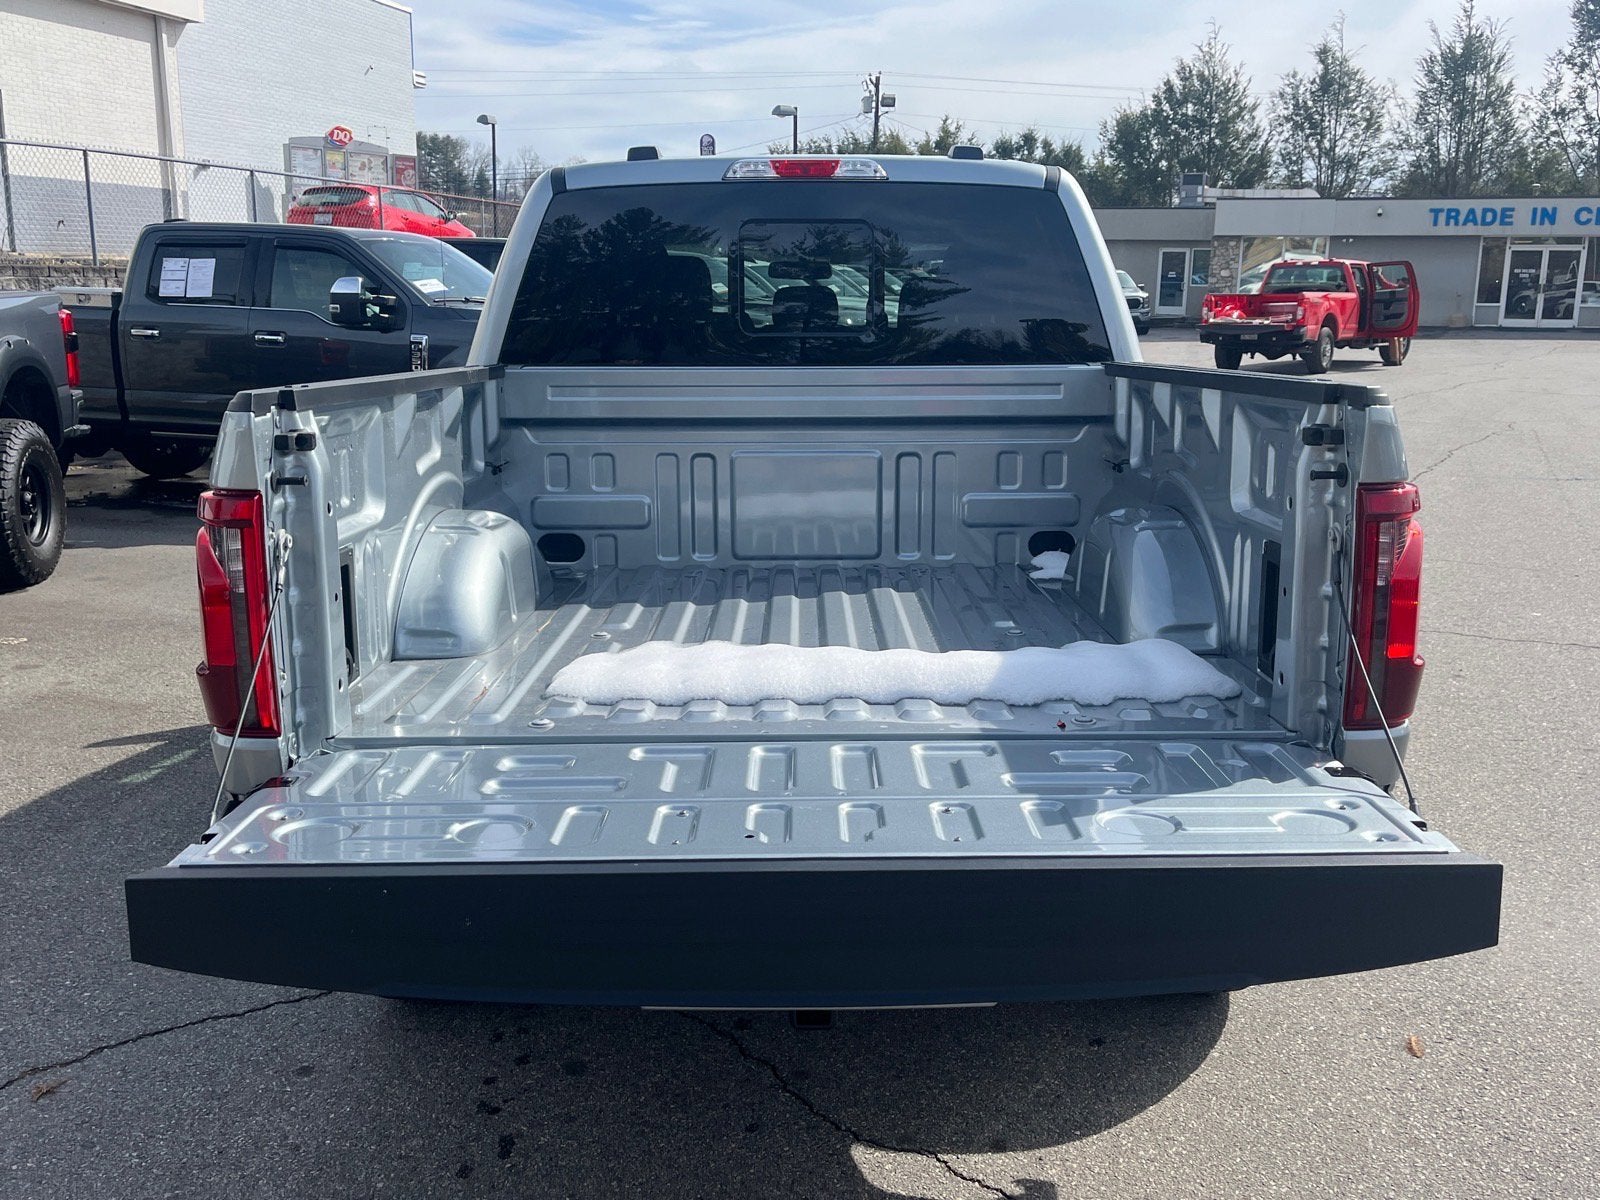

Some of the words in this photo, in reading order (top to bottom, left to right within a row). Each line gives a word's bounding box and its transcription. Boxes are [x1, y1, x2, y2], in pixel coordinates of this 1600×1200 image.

[333, 129, 351, 143] DQ
[1429, 207, 1516, 227] TRADE
[1530, 207, 1558, 226] IN
